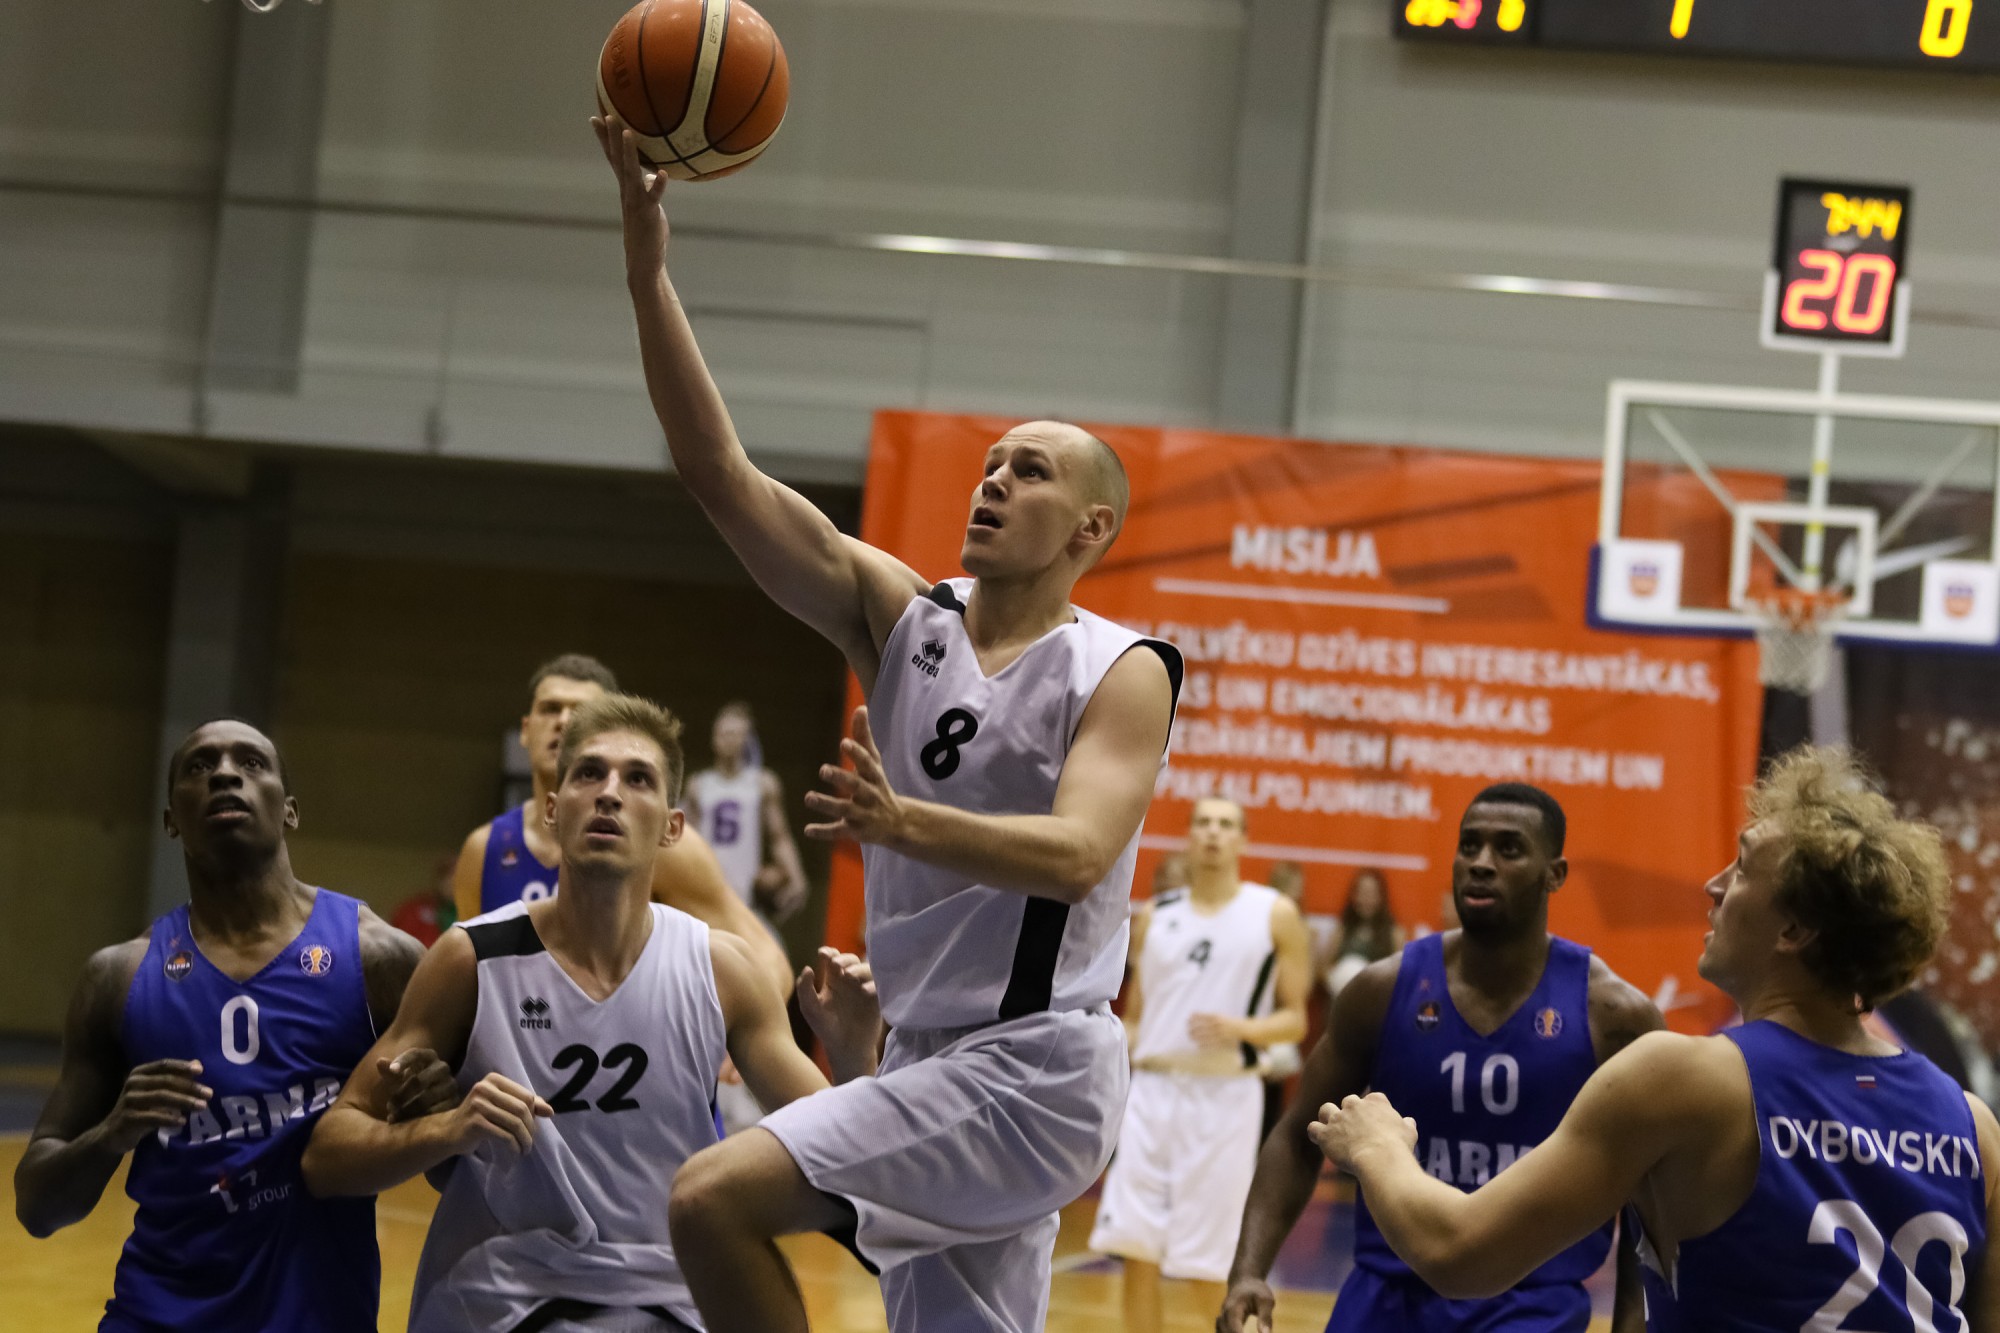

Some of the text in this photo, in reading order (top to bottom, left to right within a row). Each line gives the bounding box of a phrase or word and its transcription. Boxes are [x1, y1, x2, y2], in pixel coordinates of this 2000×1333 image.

[1781, 248, 1896, 334] 20
[1231, 524, 1381, 578] MISIJA
[1297, 627, 1416, 677] DZĪVES
[1216, 677, 1268, 712] UN
[920, 707, 978, 781] 8
[1612, 752, 1664, 790] UN
[711, 798, 743, 847] 6
[220, 994, 260, 1066] 0
[547, 1042, 648, 1114] 22
[1440, 1051, 1519, 1116] 10
[1769, 1115, 1980, 1180] DYBOVSKIY
[1799, 1199, 1970, 1333] 20
